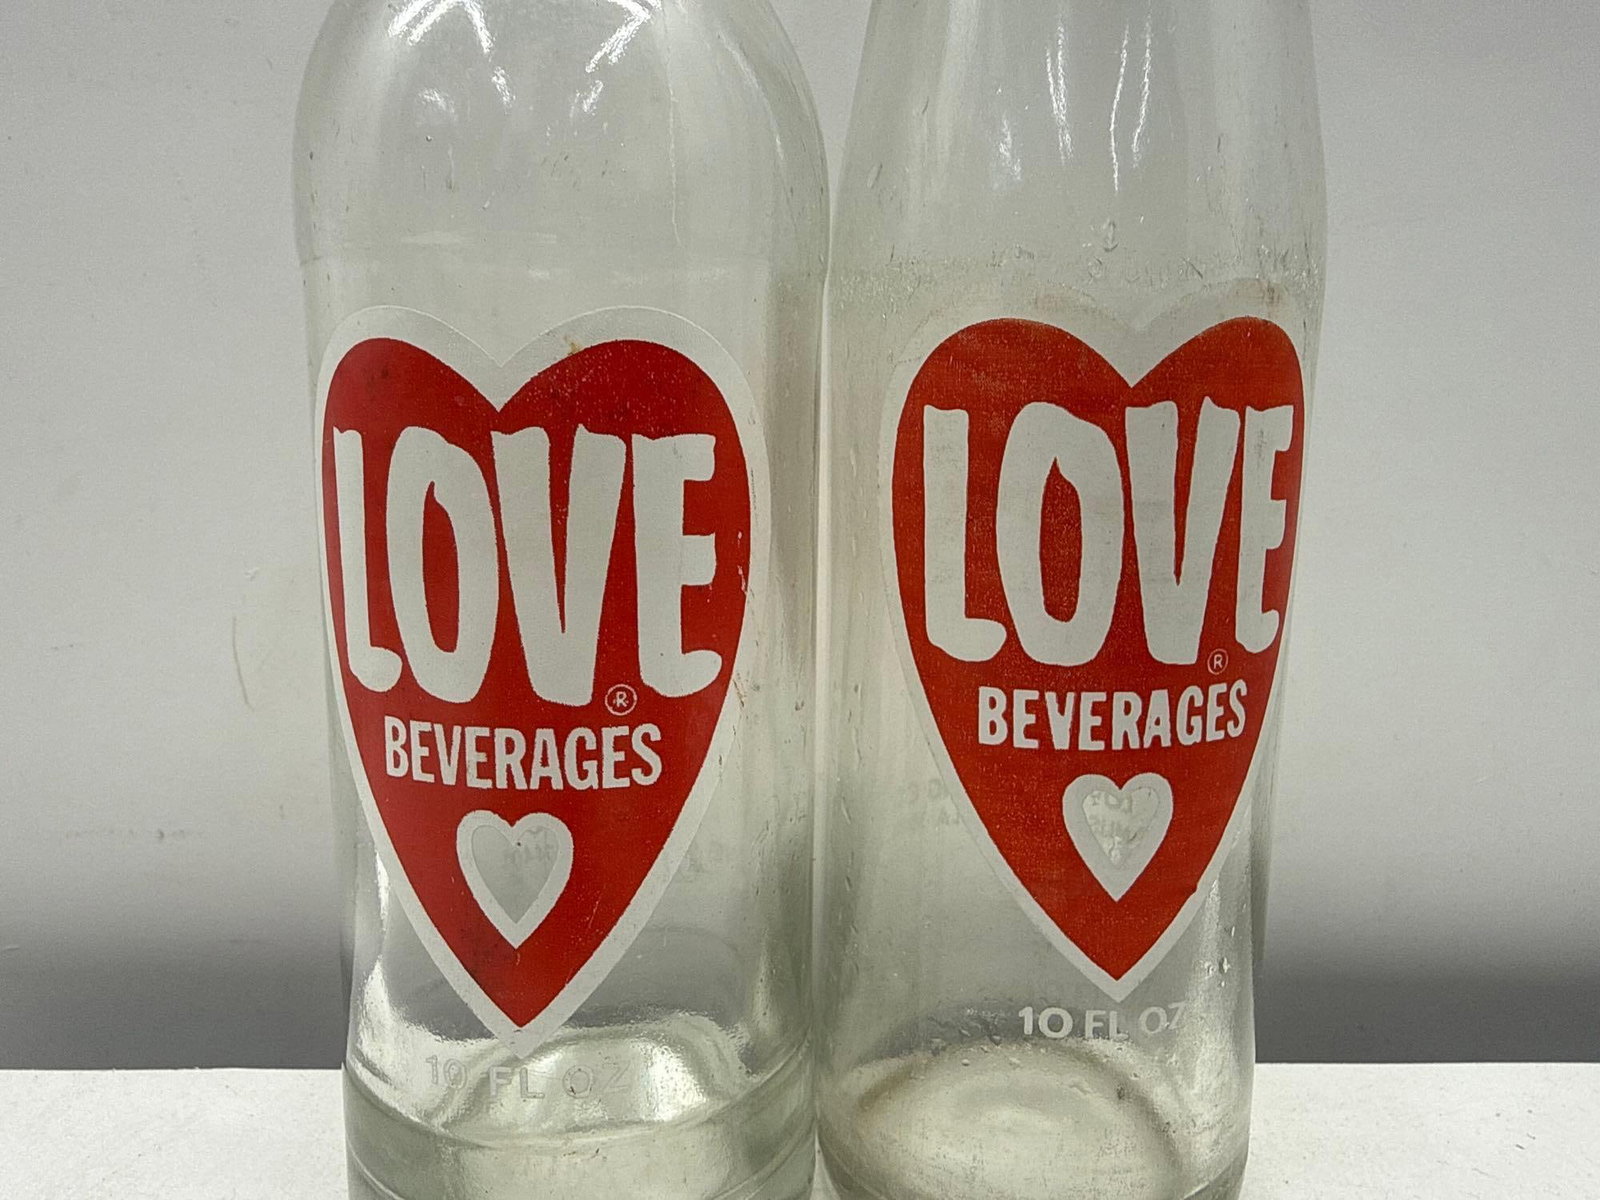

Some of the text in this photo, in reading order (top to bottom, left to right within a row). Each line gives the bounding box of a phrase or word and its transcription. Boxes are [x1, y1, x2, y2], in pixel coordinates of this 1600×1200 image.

[333, 423, 723, 706] LOVE
[923, 396, 1294, 668] LOVE
[978, 678, 1248, 751] BEVERAGES
[384, 715, 662, 790] BEVERAGES
[1018, 1005, 1074, 1039] 10
[1084, 1009, 1129, 1040] FL
[425, 1054, 633, 1100] 10 FL OZ
